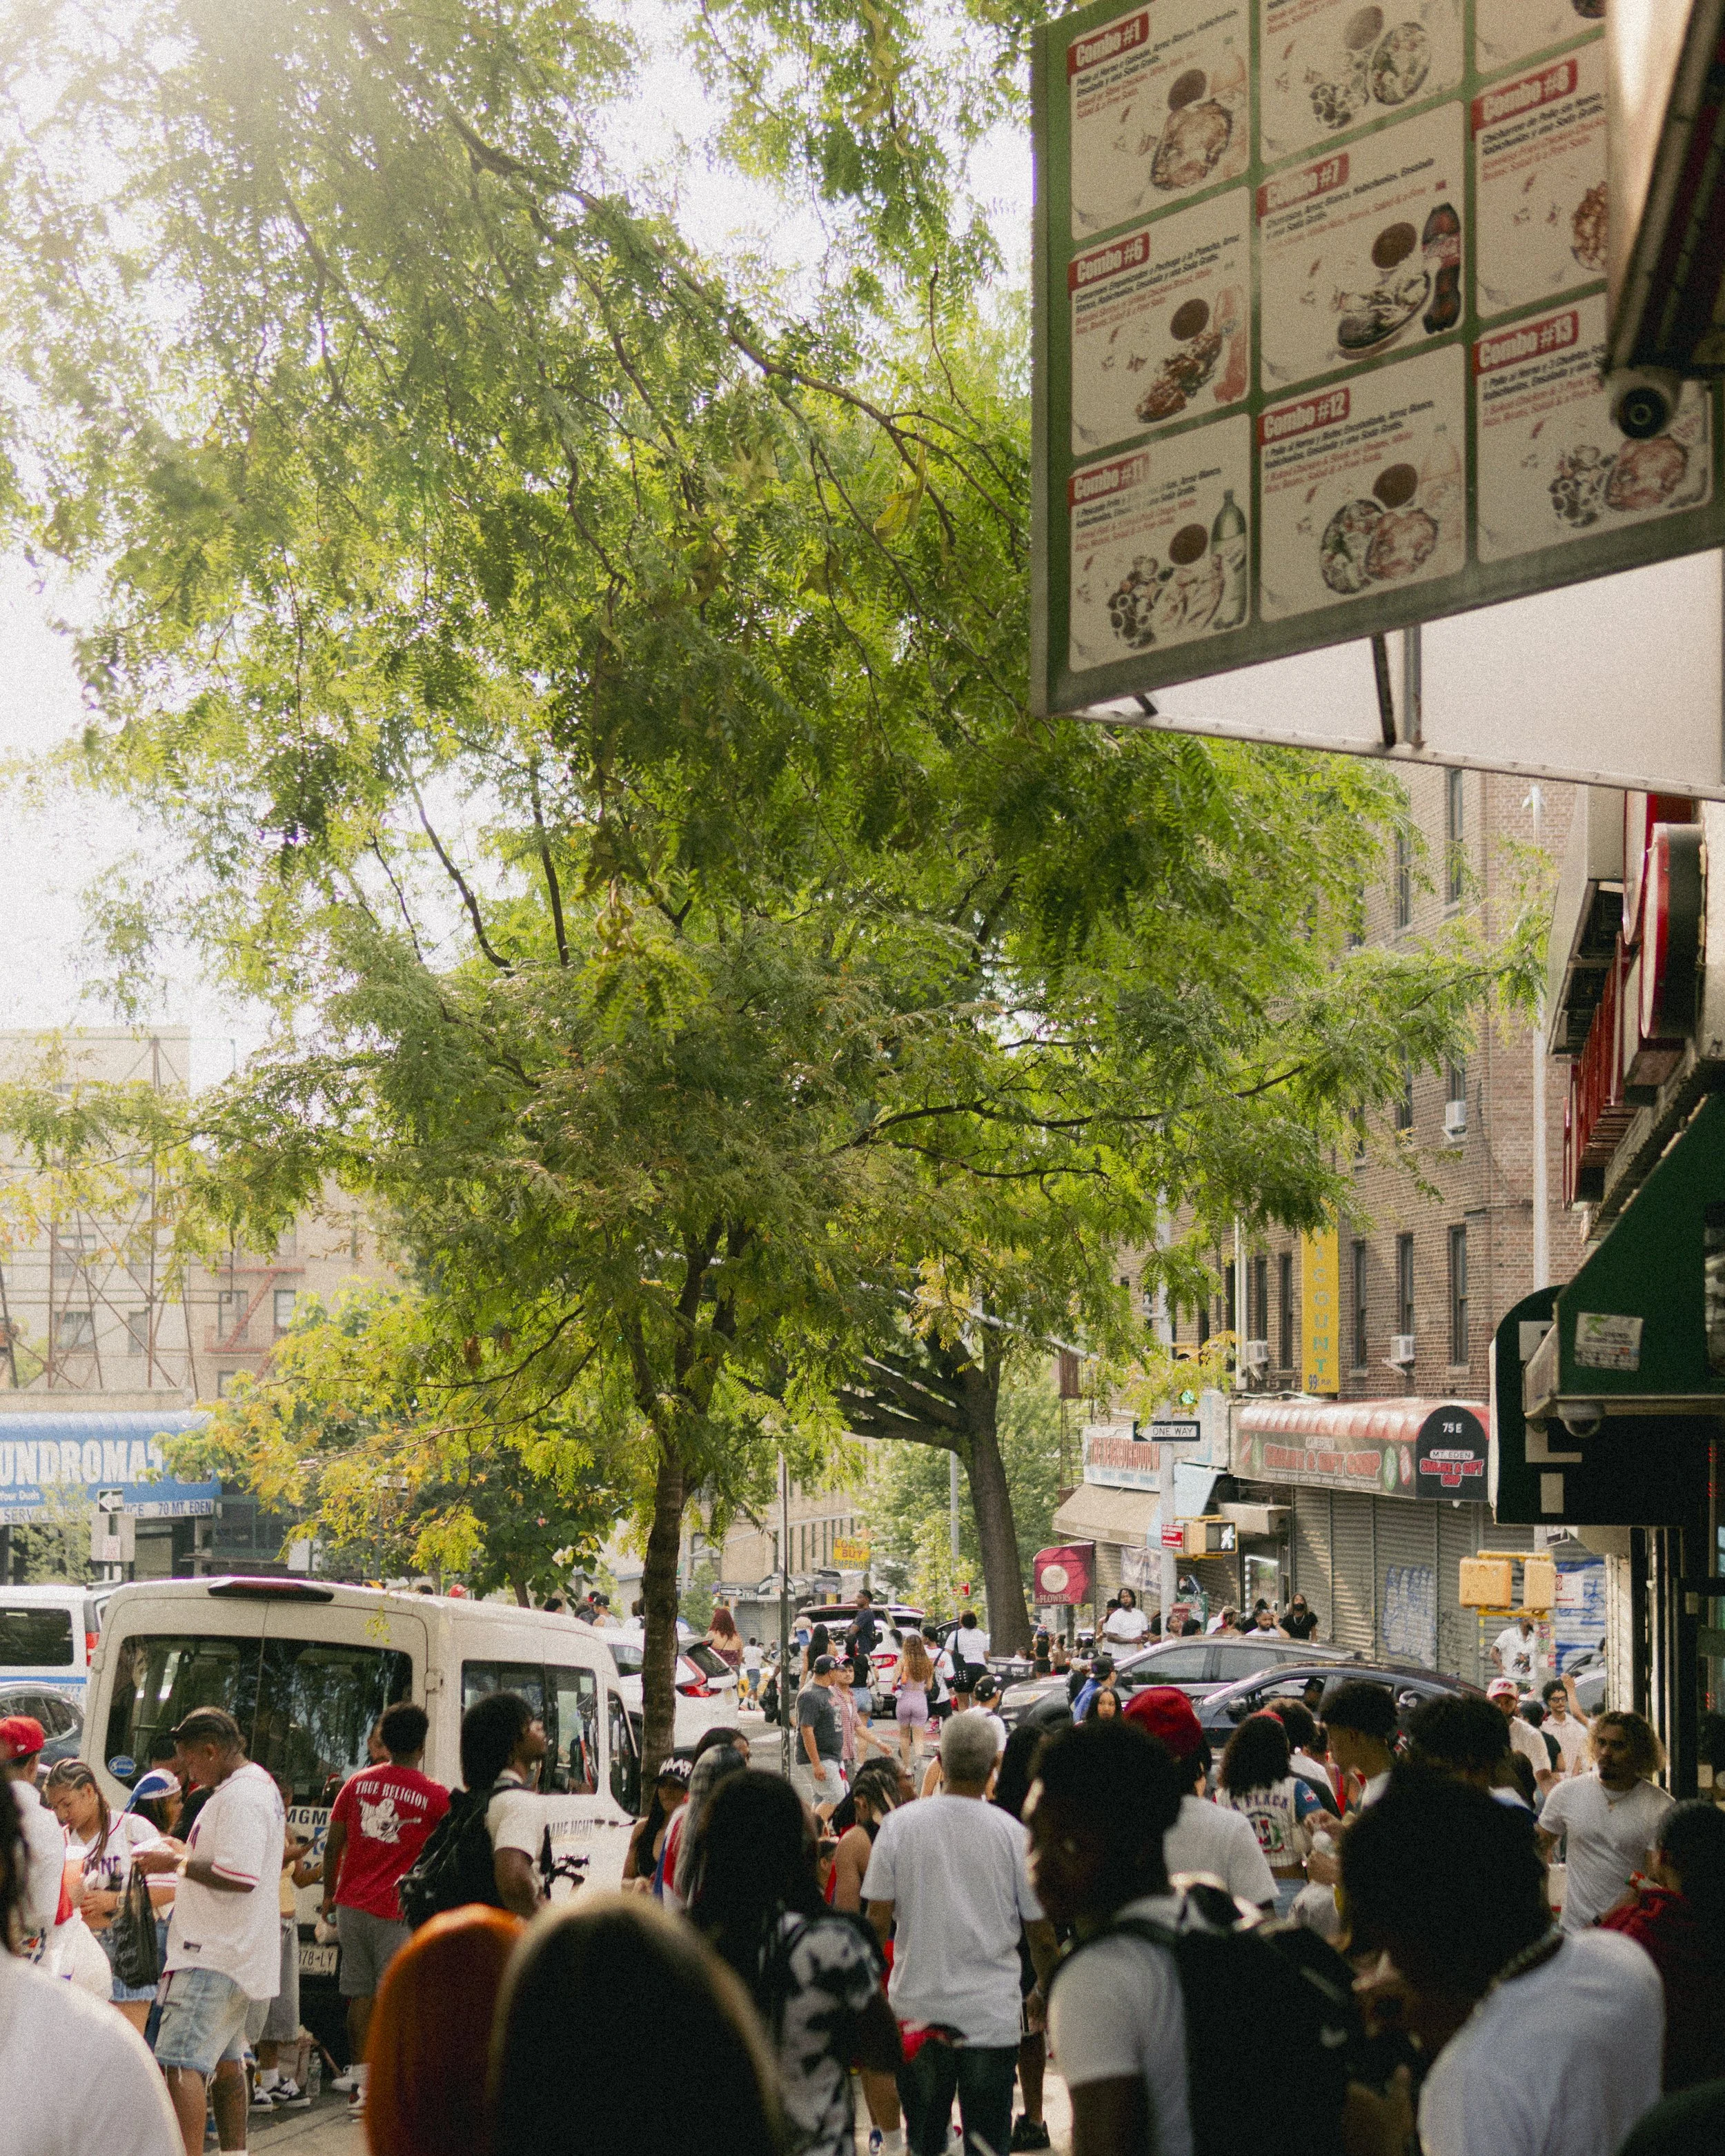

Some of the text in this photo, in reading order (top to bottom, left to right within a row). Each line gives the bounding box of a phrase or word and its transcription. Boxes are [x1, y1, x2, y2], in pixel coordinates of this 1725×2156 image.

[1076, 19, 1141, 68] Combo #1
[1077, 237, 1143, 283] Combo #6
[1479, 331, 1537, 368] Combo
[1263, 393, 1345, 439] Combo #12
[1074, 467, 1118, 500] Combo
[1152, 1426, 1193, 1436] ONE WAY
[1442, 1422, 1463, 1433] 75 E
[157, 1503, 170, 1515] 70
[172, 1501, 187, 1514] MT.
[189, 1499, 212, 1513] EDEN
[1040, 1594, 1071, 1603] FLOWERS
[355, 1781, 429, 1812] TRUE RELIGION
